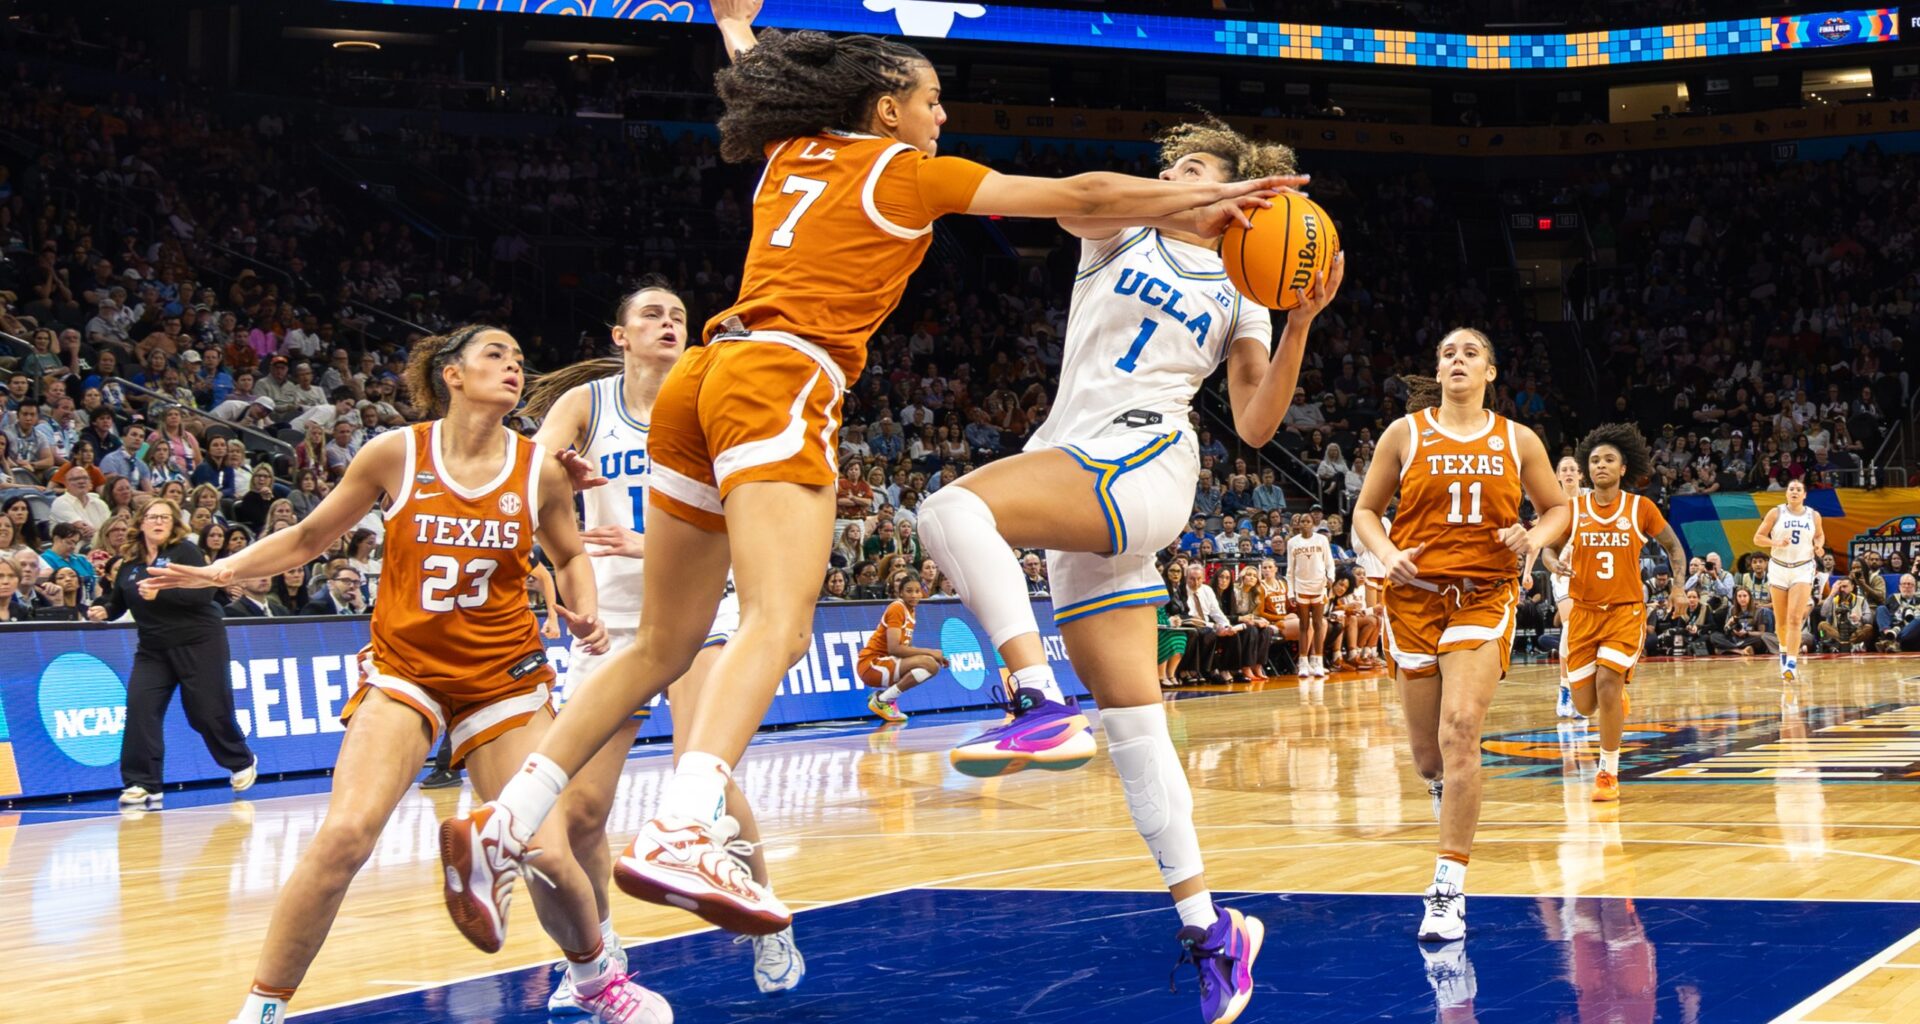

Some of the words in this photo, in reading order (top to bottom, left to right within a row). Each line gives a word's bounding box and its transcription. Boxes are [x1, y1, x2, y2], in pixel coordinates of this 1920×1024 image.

[769, 173, 828, 248] 7
[1288, 215, 1318, 291] Wilson
[1113, 267, 1212, 349] UCLA
[1114, 317, 1159, 374] 1
[1426, 453, 1504, 476] TEXAS
[627, 486, 645, 534] 1
[1446, 480, 1483, 524] 11
[414, 513, 520, 549] TEXAS
[1580, 532, 1630, 547] TEXAS
[1783, 520, 1811, 531] UCLA
[1791, 530, 1801, 545] 5
[421, 553, 498, 612] 23
[1596, 551, 1614, 580] 3
[950, 651, 986, 673] NCAA
